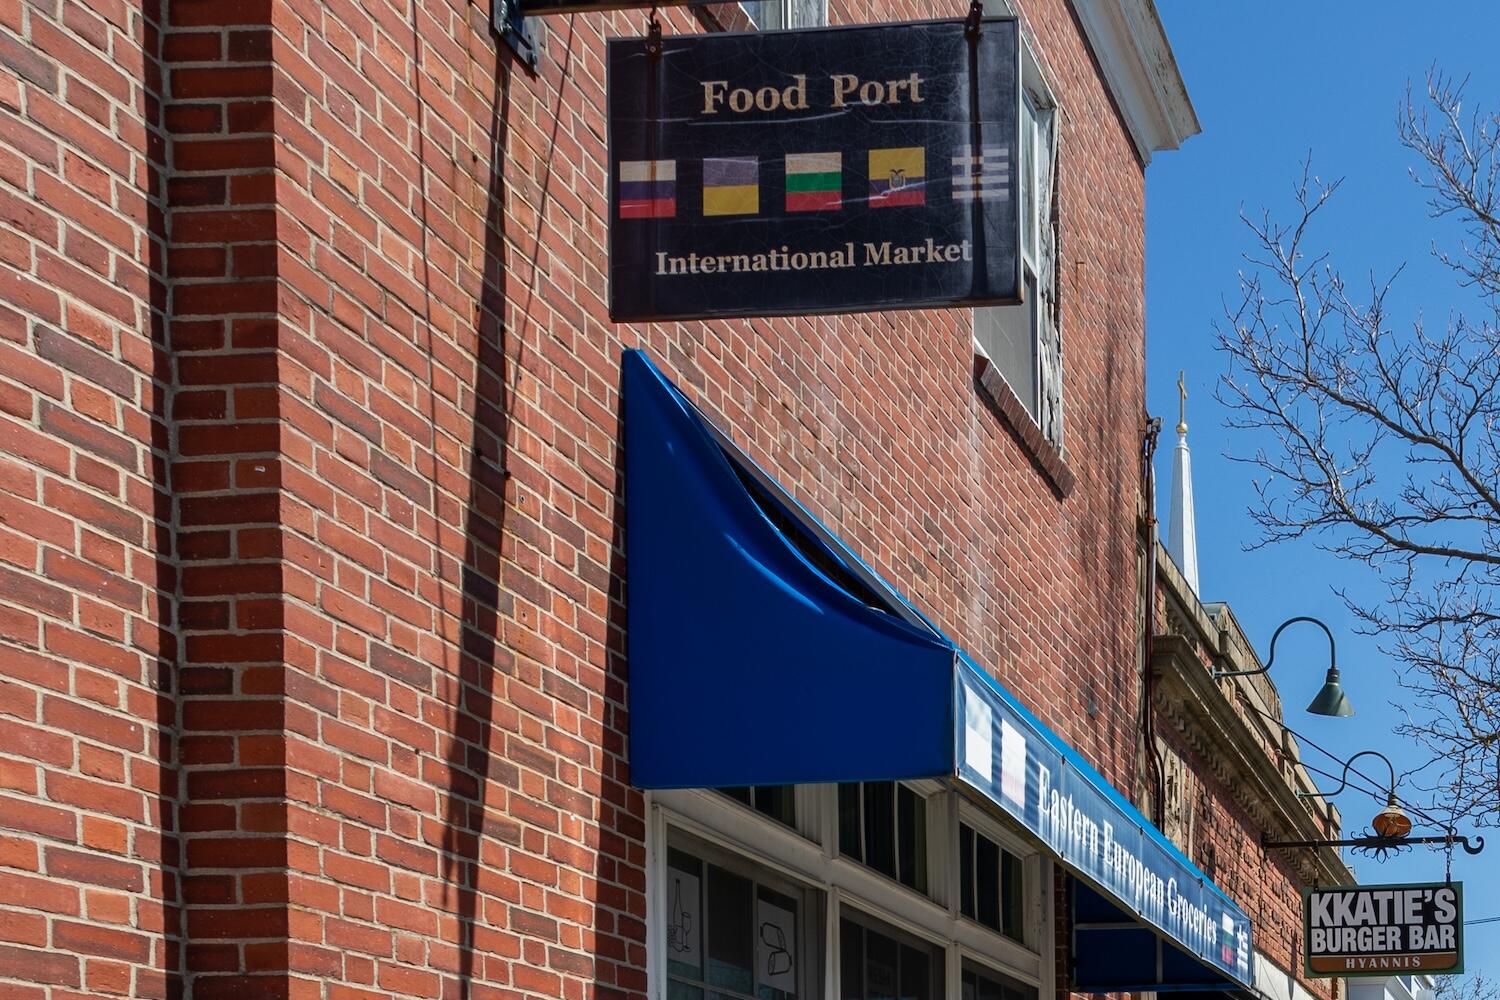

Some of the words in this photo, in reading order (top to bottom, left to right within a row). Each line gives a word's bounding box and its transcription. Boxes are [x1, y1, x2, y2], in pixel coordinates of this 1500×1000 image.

[700, 74, 808, 116] Food
[830, 71, 925, 108] Port
[655, 243, 855, 277] International
[864, 238, 974, 267] Market
[1037, 761, 1099, 854] Eastern
[1102, 820, 1164, 904] European
[1167, 876, 1217, 945] Groceries
[1310, 888, 1457, 928] KKATIE'S
[1311, 926, 1402, 953] BURGER
[1408, 924, 1457, 951] BAR
[1345, 955, 1421, 970] HYANNIS
